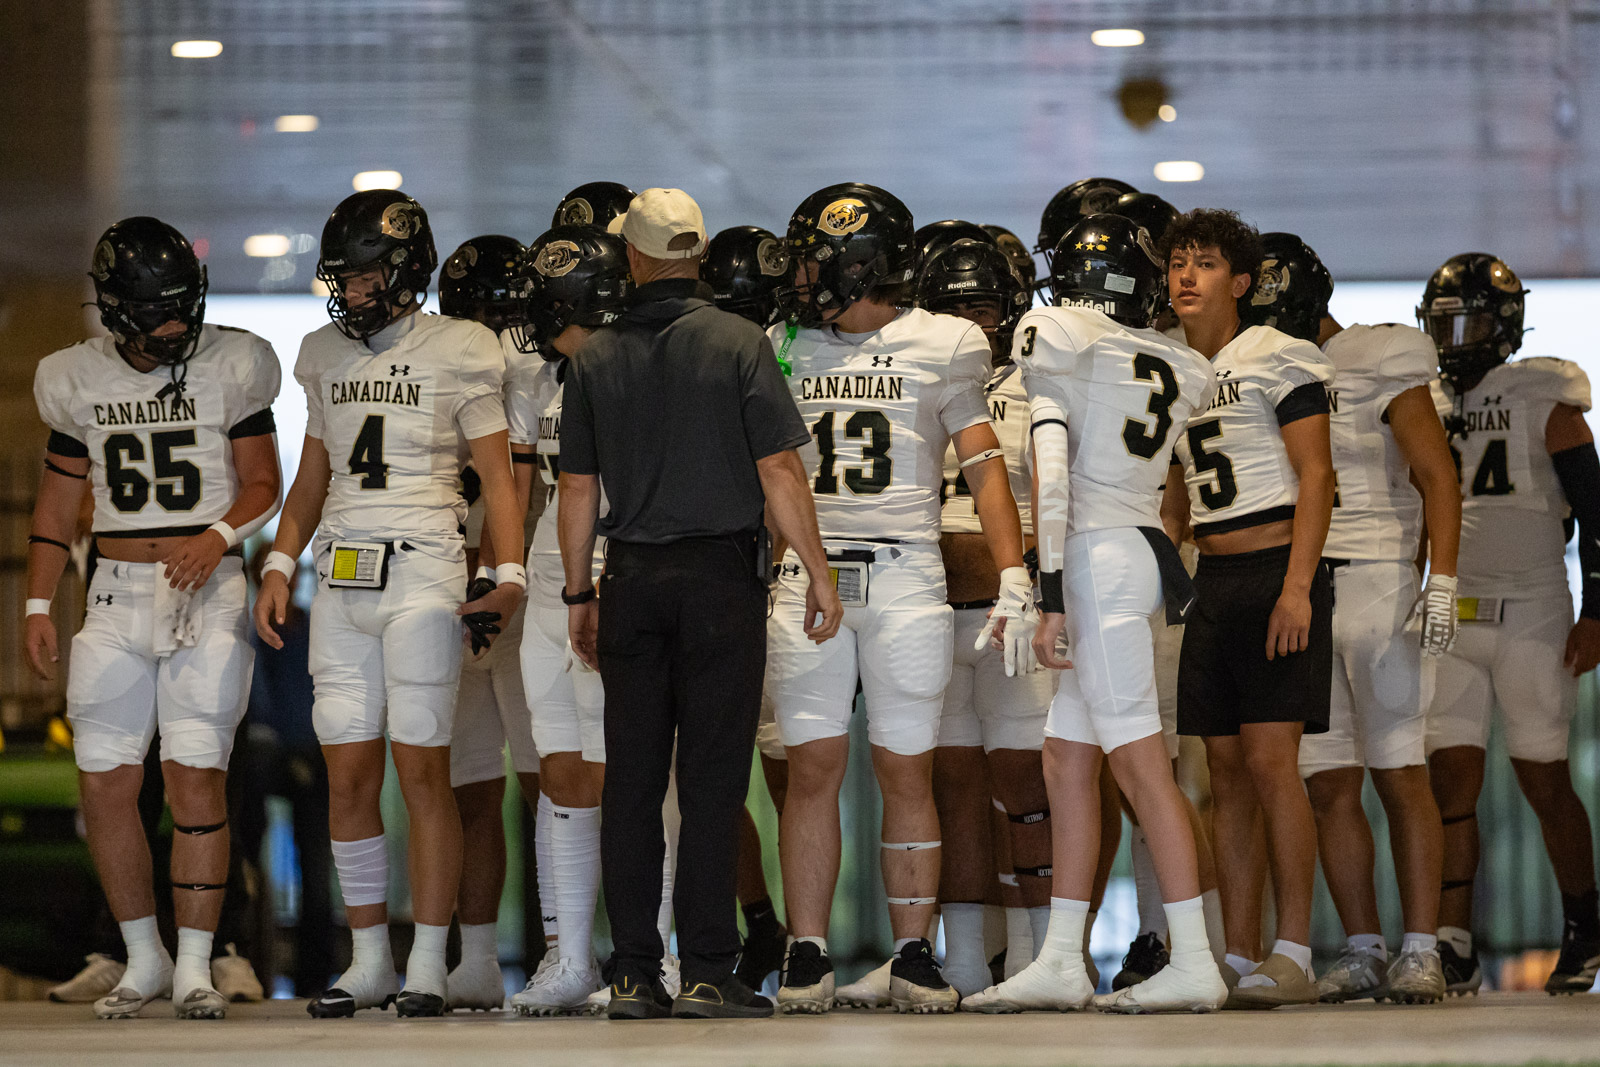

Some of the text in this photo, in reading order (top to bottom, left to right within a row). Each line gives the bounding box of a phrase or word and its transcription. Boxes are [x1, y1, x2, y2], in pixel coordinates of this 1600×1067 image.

[1084, 260, 1092, 271] 3
[947, 281, 977, 290] Riddell
[1021, 325, 1038, 357] 3
[331, 381, 421, 406] CANADIAN
[801, 376, 903, 400] CANADIAN
[94, 398, 197, 425] CANADIAN
[1120, 351, 1181, 462] 3
[347, 413, 389, 491] 4
[811, 408, 894, 497] 13
[1186, 417, 1240, 513] 5
[102, 426, 204, 514] 65
